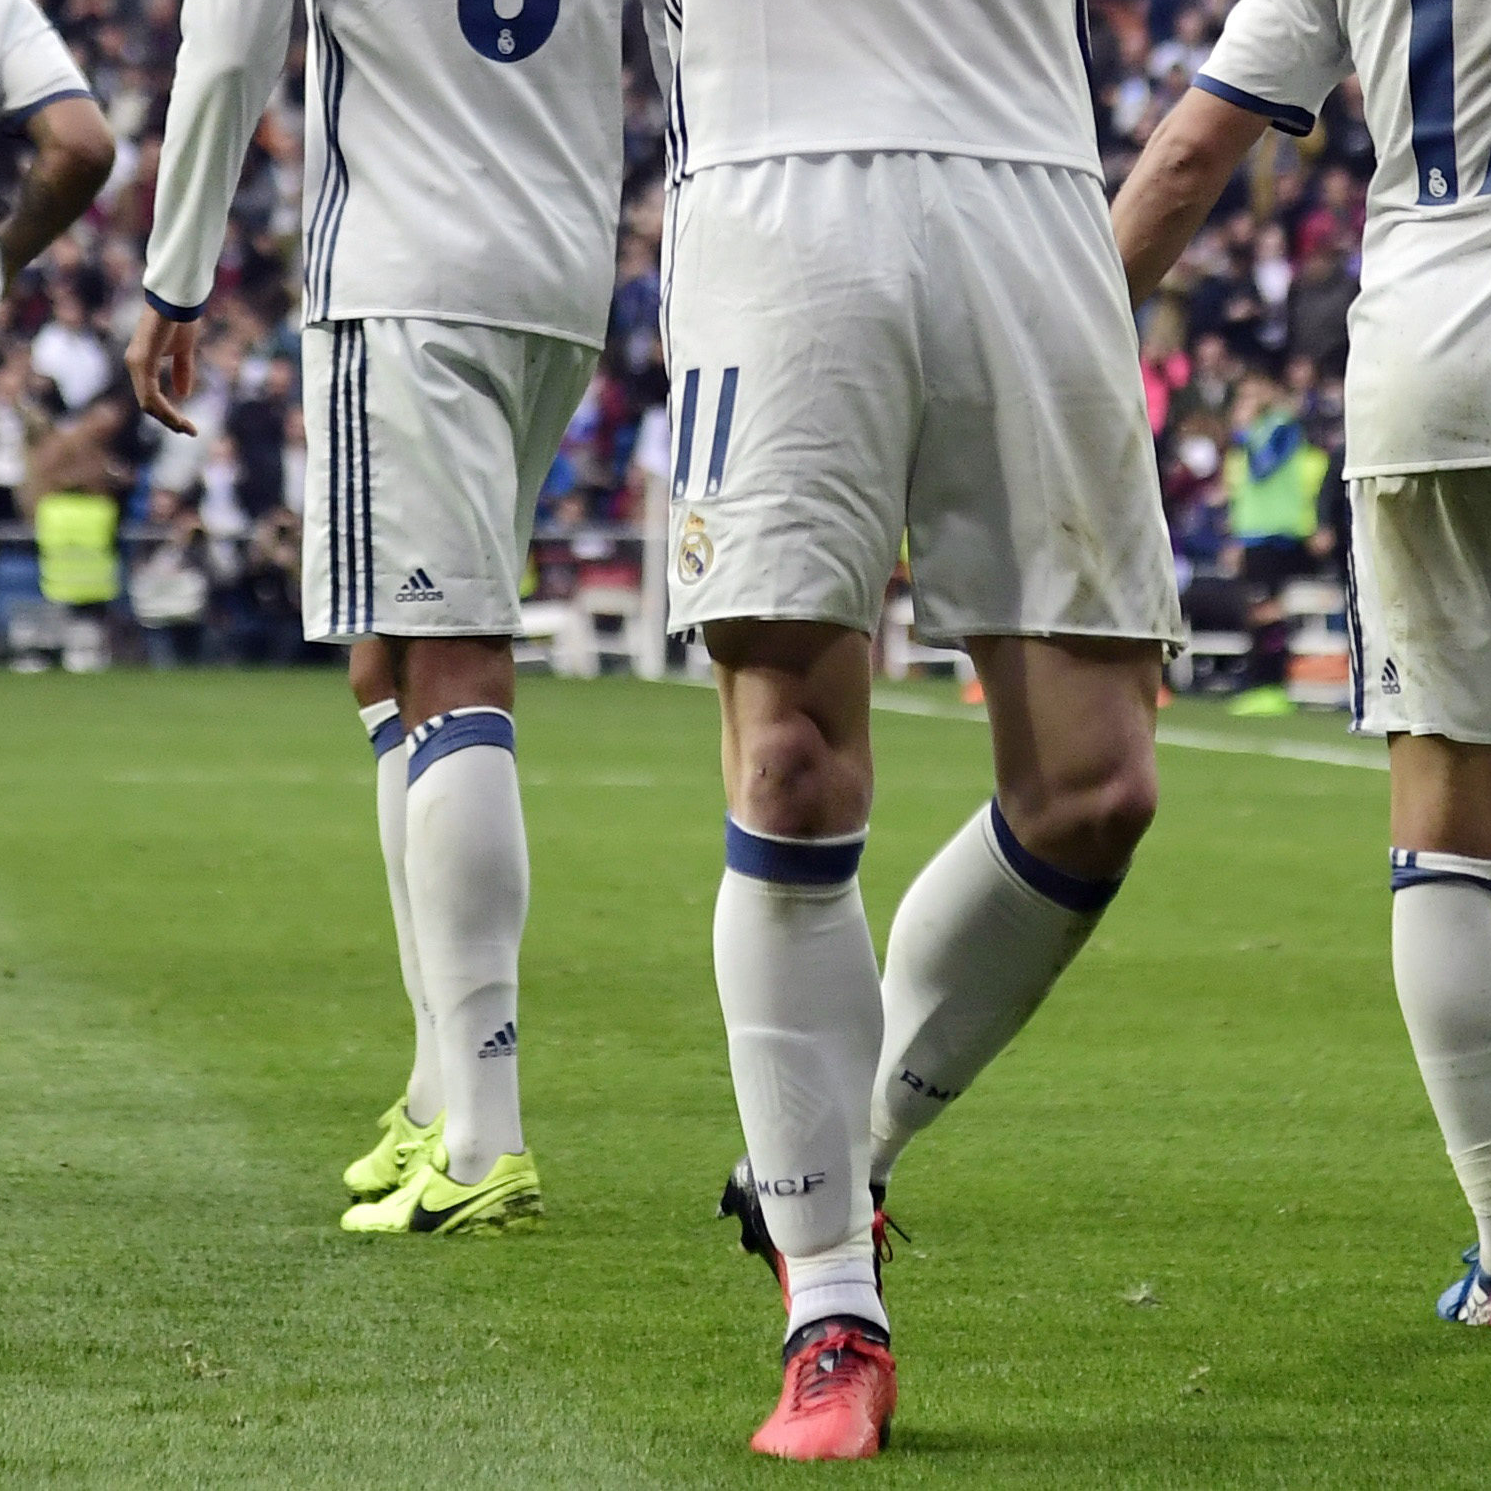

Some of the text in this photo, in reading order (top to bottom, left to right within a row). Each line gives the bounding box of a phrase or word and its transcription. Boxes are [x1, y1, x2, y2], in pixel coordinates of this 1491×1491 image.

[672, 366, 740, 501] 11
[394, 588, 445, 603] adidas
[899, 1069, 964, 1102] RM
